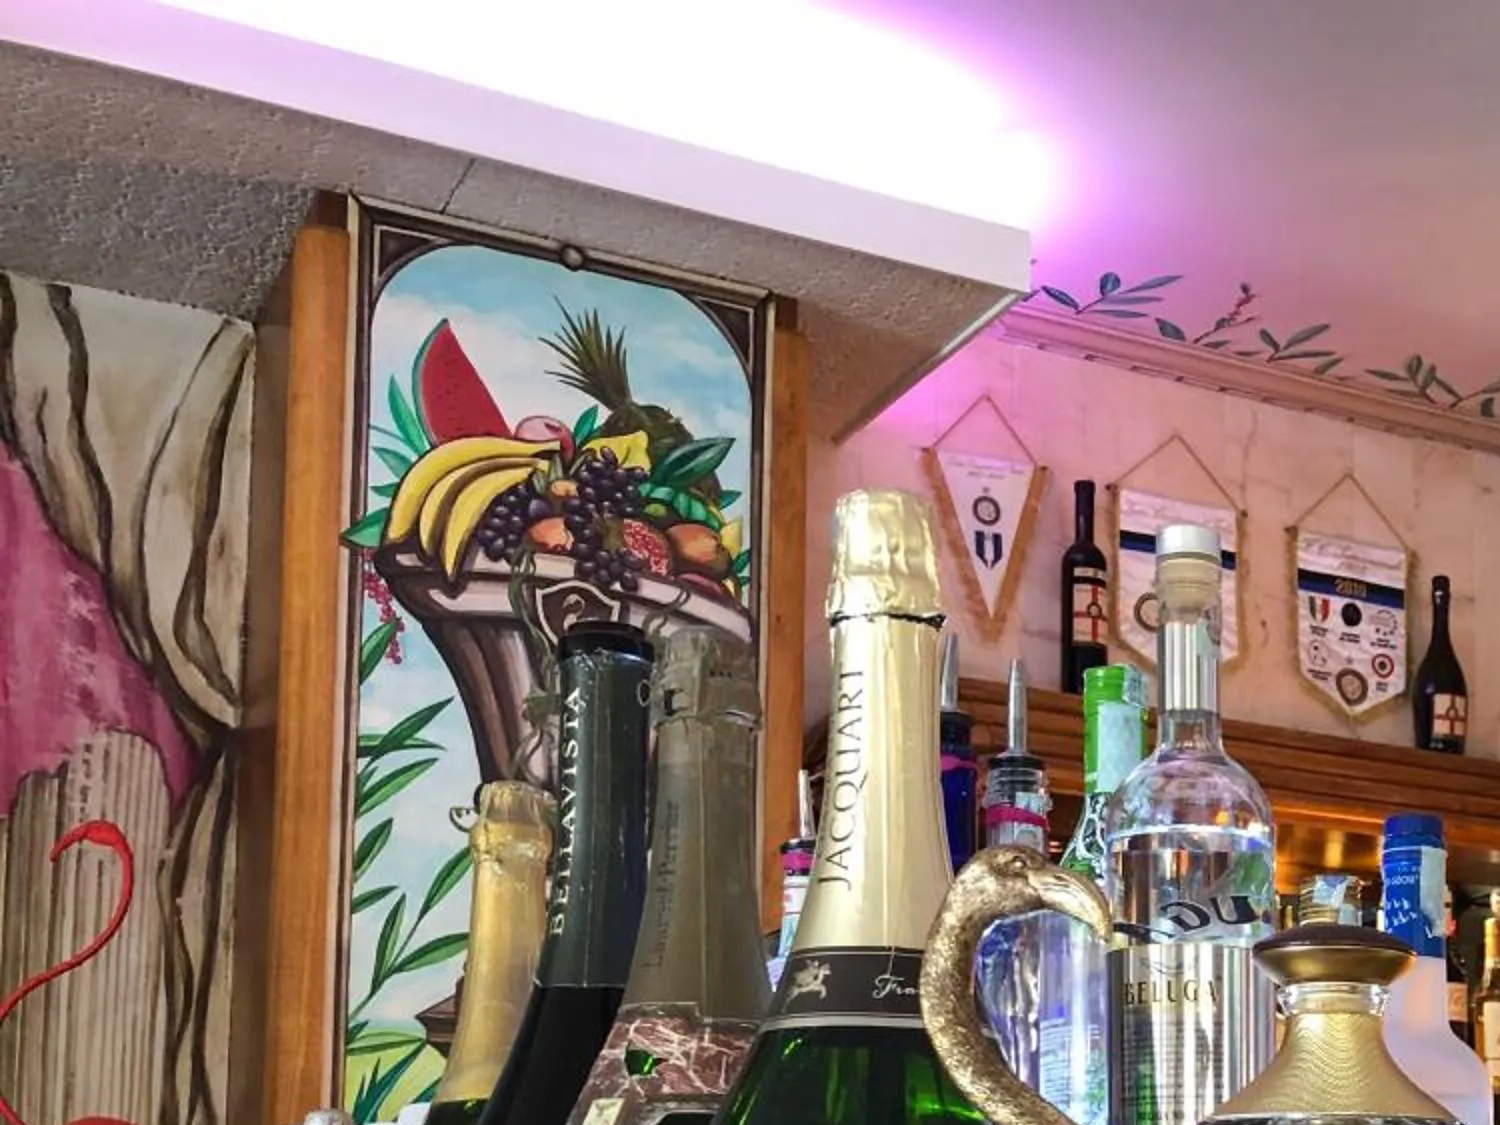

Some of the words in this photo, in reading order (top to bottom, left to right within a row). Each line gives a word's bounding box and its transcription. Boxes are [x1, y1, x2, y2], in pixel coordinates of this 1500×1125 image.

[550, 687, 588, 937] BELLAVISTA
[817, 667, 868, 891] JACQUART
[1125, 977, 1219, 1006] BELUGA
